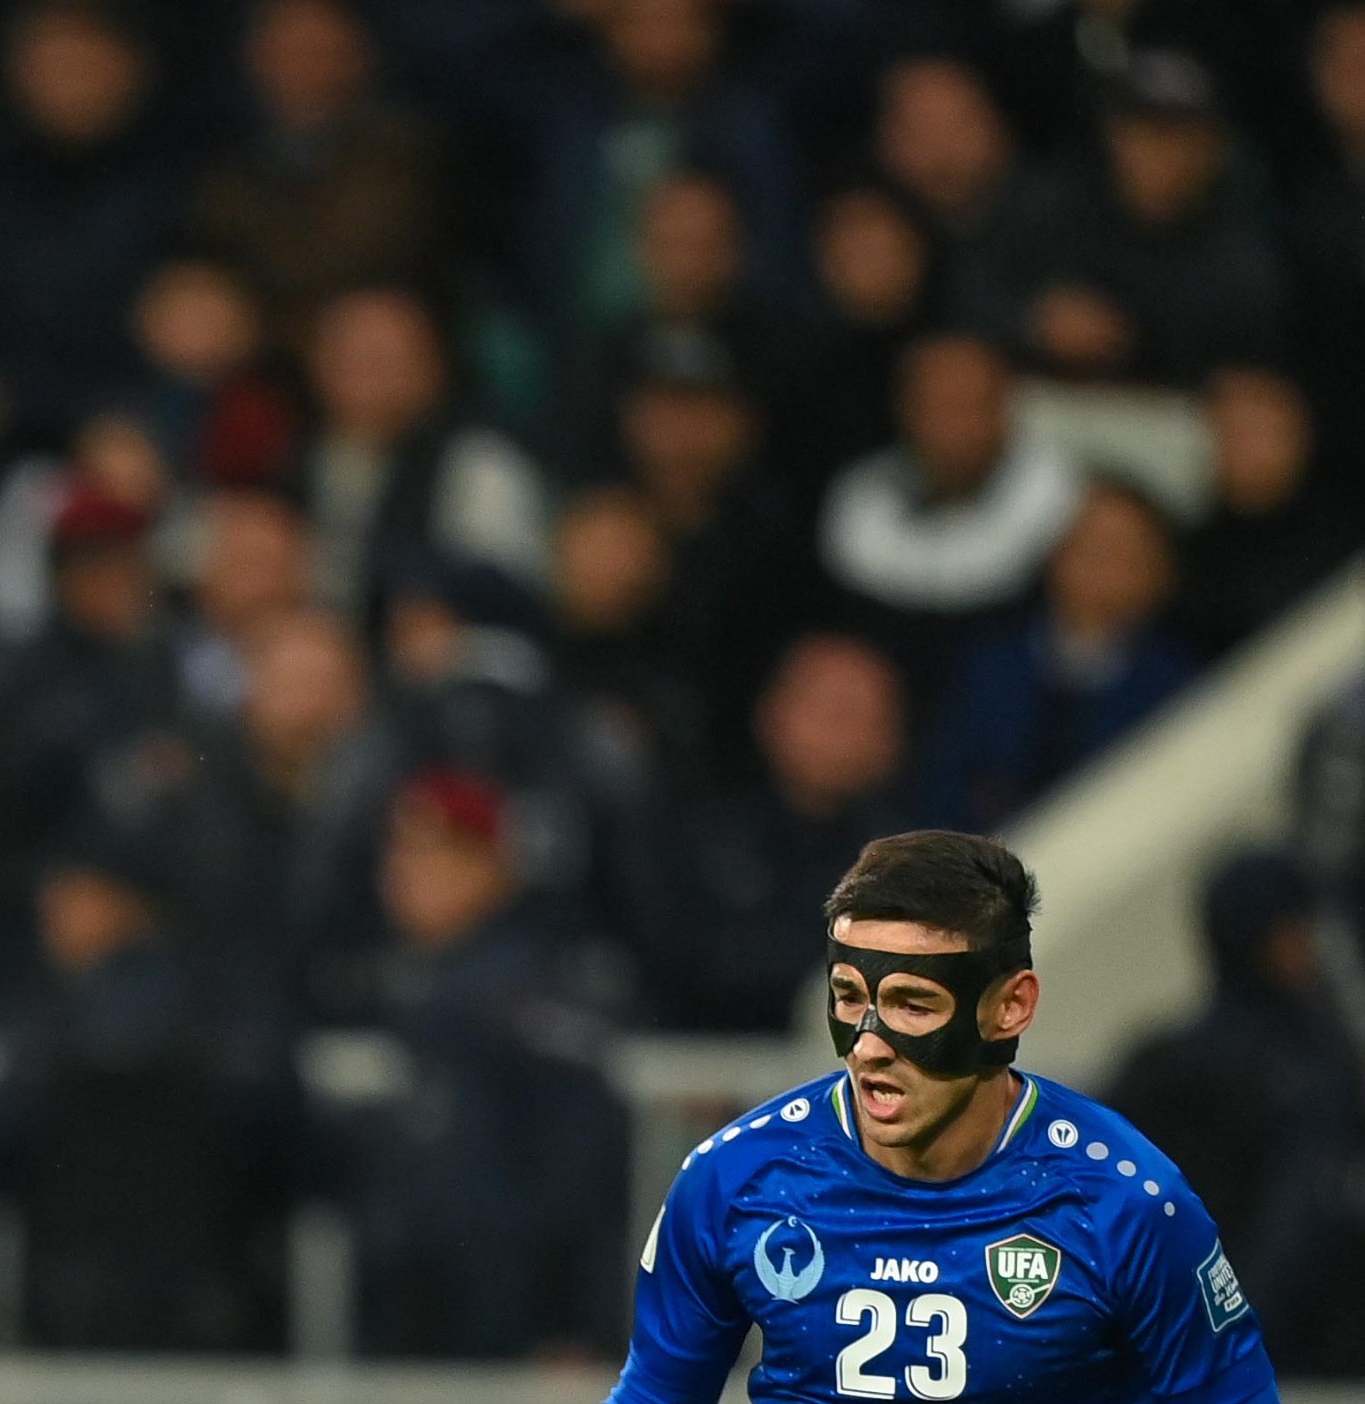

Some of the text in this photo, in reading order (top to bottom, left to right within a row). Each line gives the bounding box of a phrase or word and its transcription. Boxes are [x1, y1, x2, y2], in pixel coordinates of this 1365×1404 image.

[870, 1257, 939, 1284] JAKO
[998, 1251, 1048, 1280] UFA
[836, 1289, 968, 1401] 23
